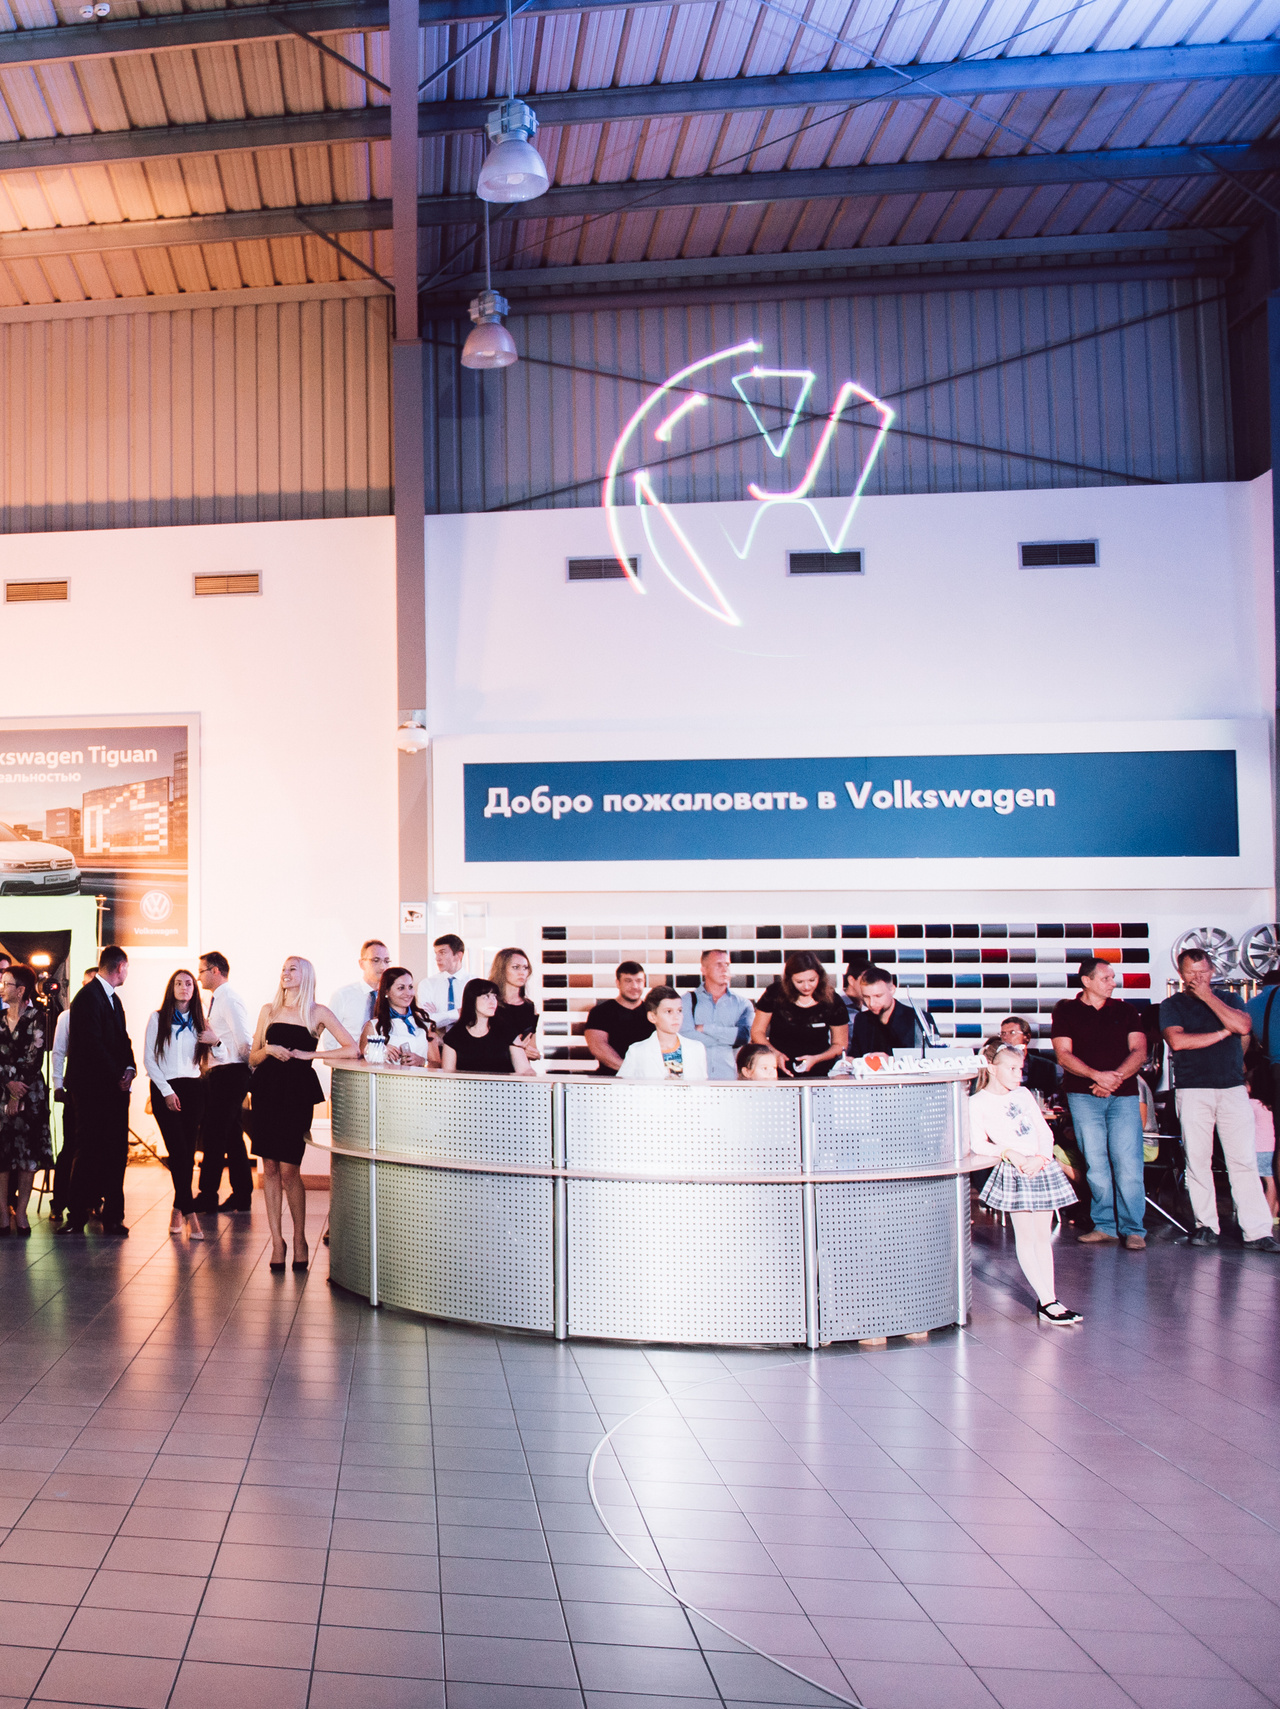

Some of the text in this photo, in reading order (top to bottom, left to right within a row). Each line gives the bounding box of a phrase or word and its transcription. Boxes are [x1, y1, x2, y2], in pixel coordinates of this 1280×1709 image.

[87, 745, 158, 768] Tiguan
[483, 779, 1056, 820] Добро пожаловать в Volkswagen
[133, 927, 179, 936] Volkswagen
[880, 1054, 989, 1073] Volkswagen
